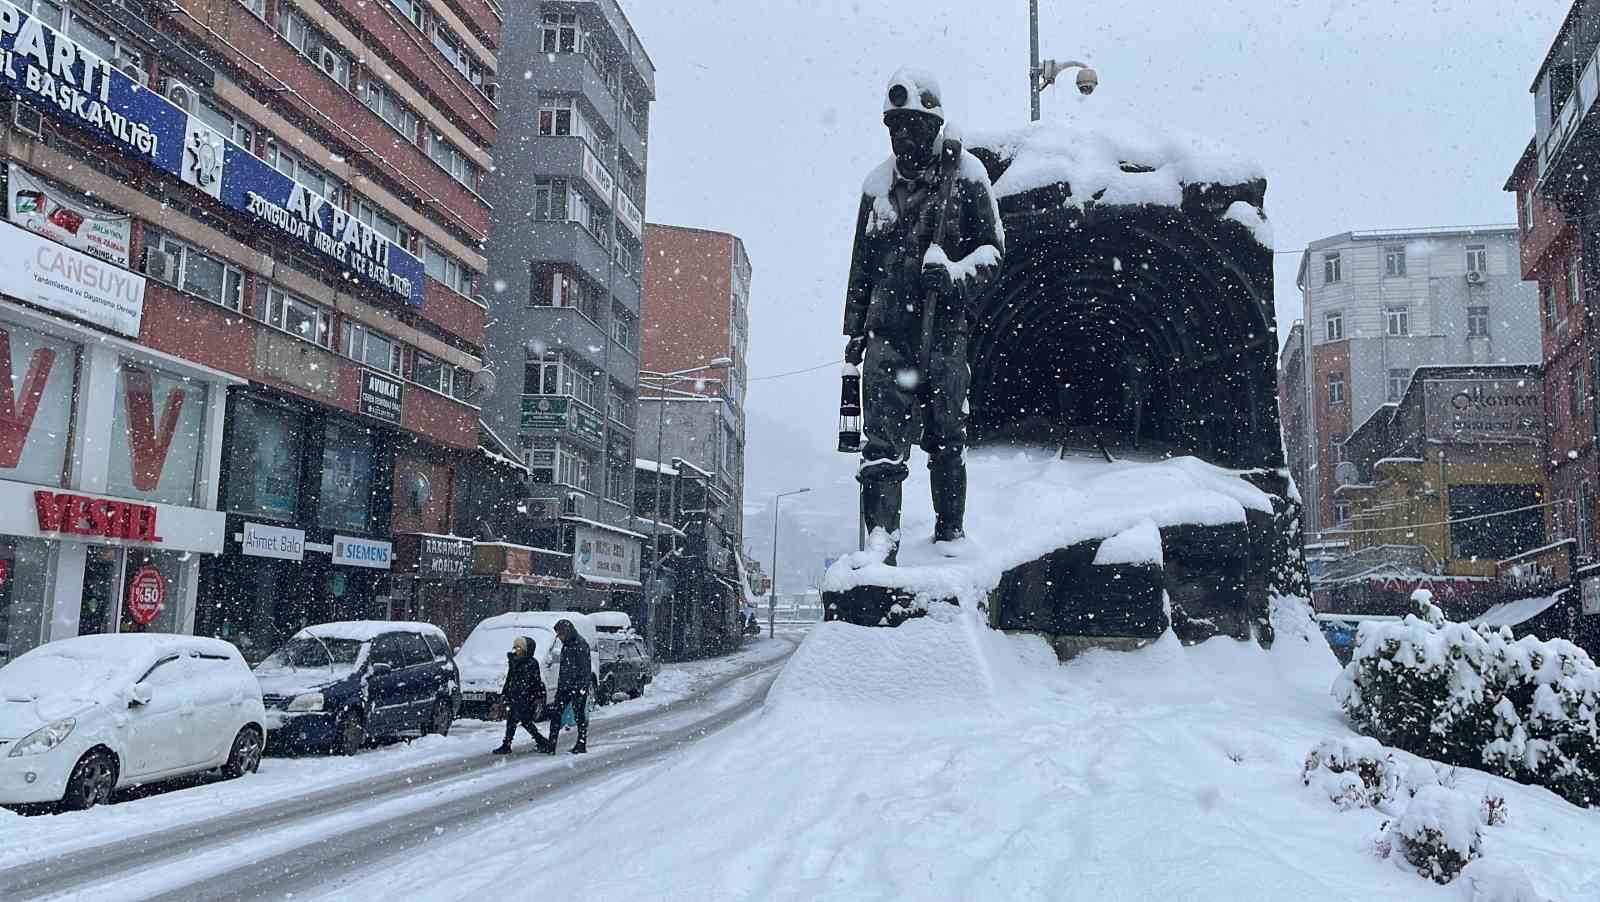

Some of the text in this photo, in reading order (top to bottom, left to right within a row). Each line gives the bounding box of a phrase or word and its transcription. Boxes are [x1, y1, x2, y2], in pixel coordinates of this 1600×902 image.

[286, 182, 322, 229] AK
[246, 191, 310, 243] ZONGULDAK
[313, 230, 347, 263] MERKEZ
[37, 247, 139, 302] CANSUYU
[246, 529, 278, 550] Ahmet
[346, 542, 388, 562] SIEMENS
[135, 587, 159, 602] %50
